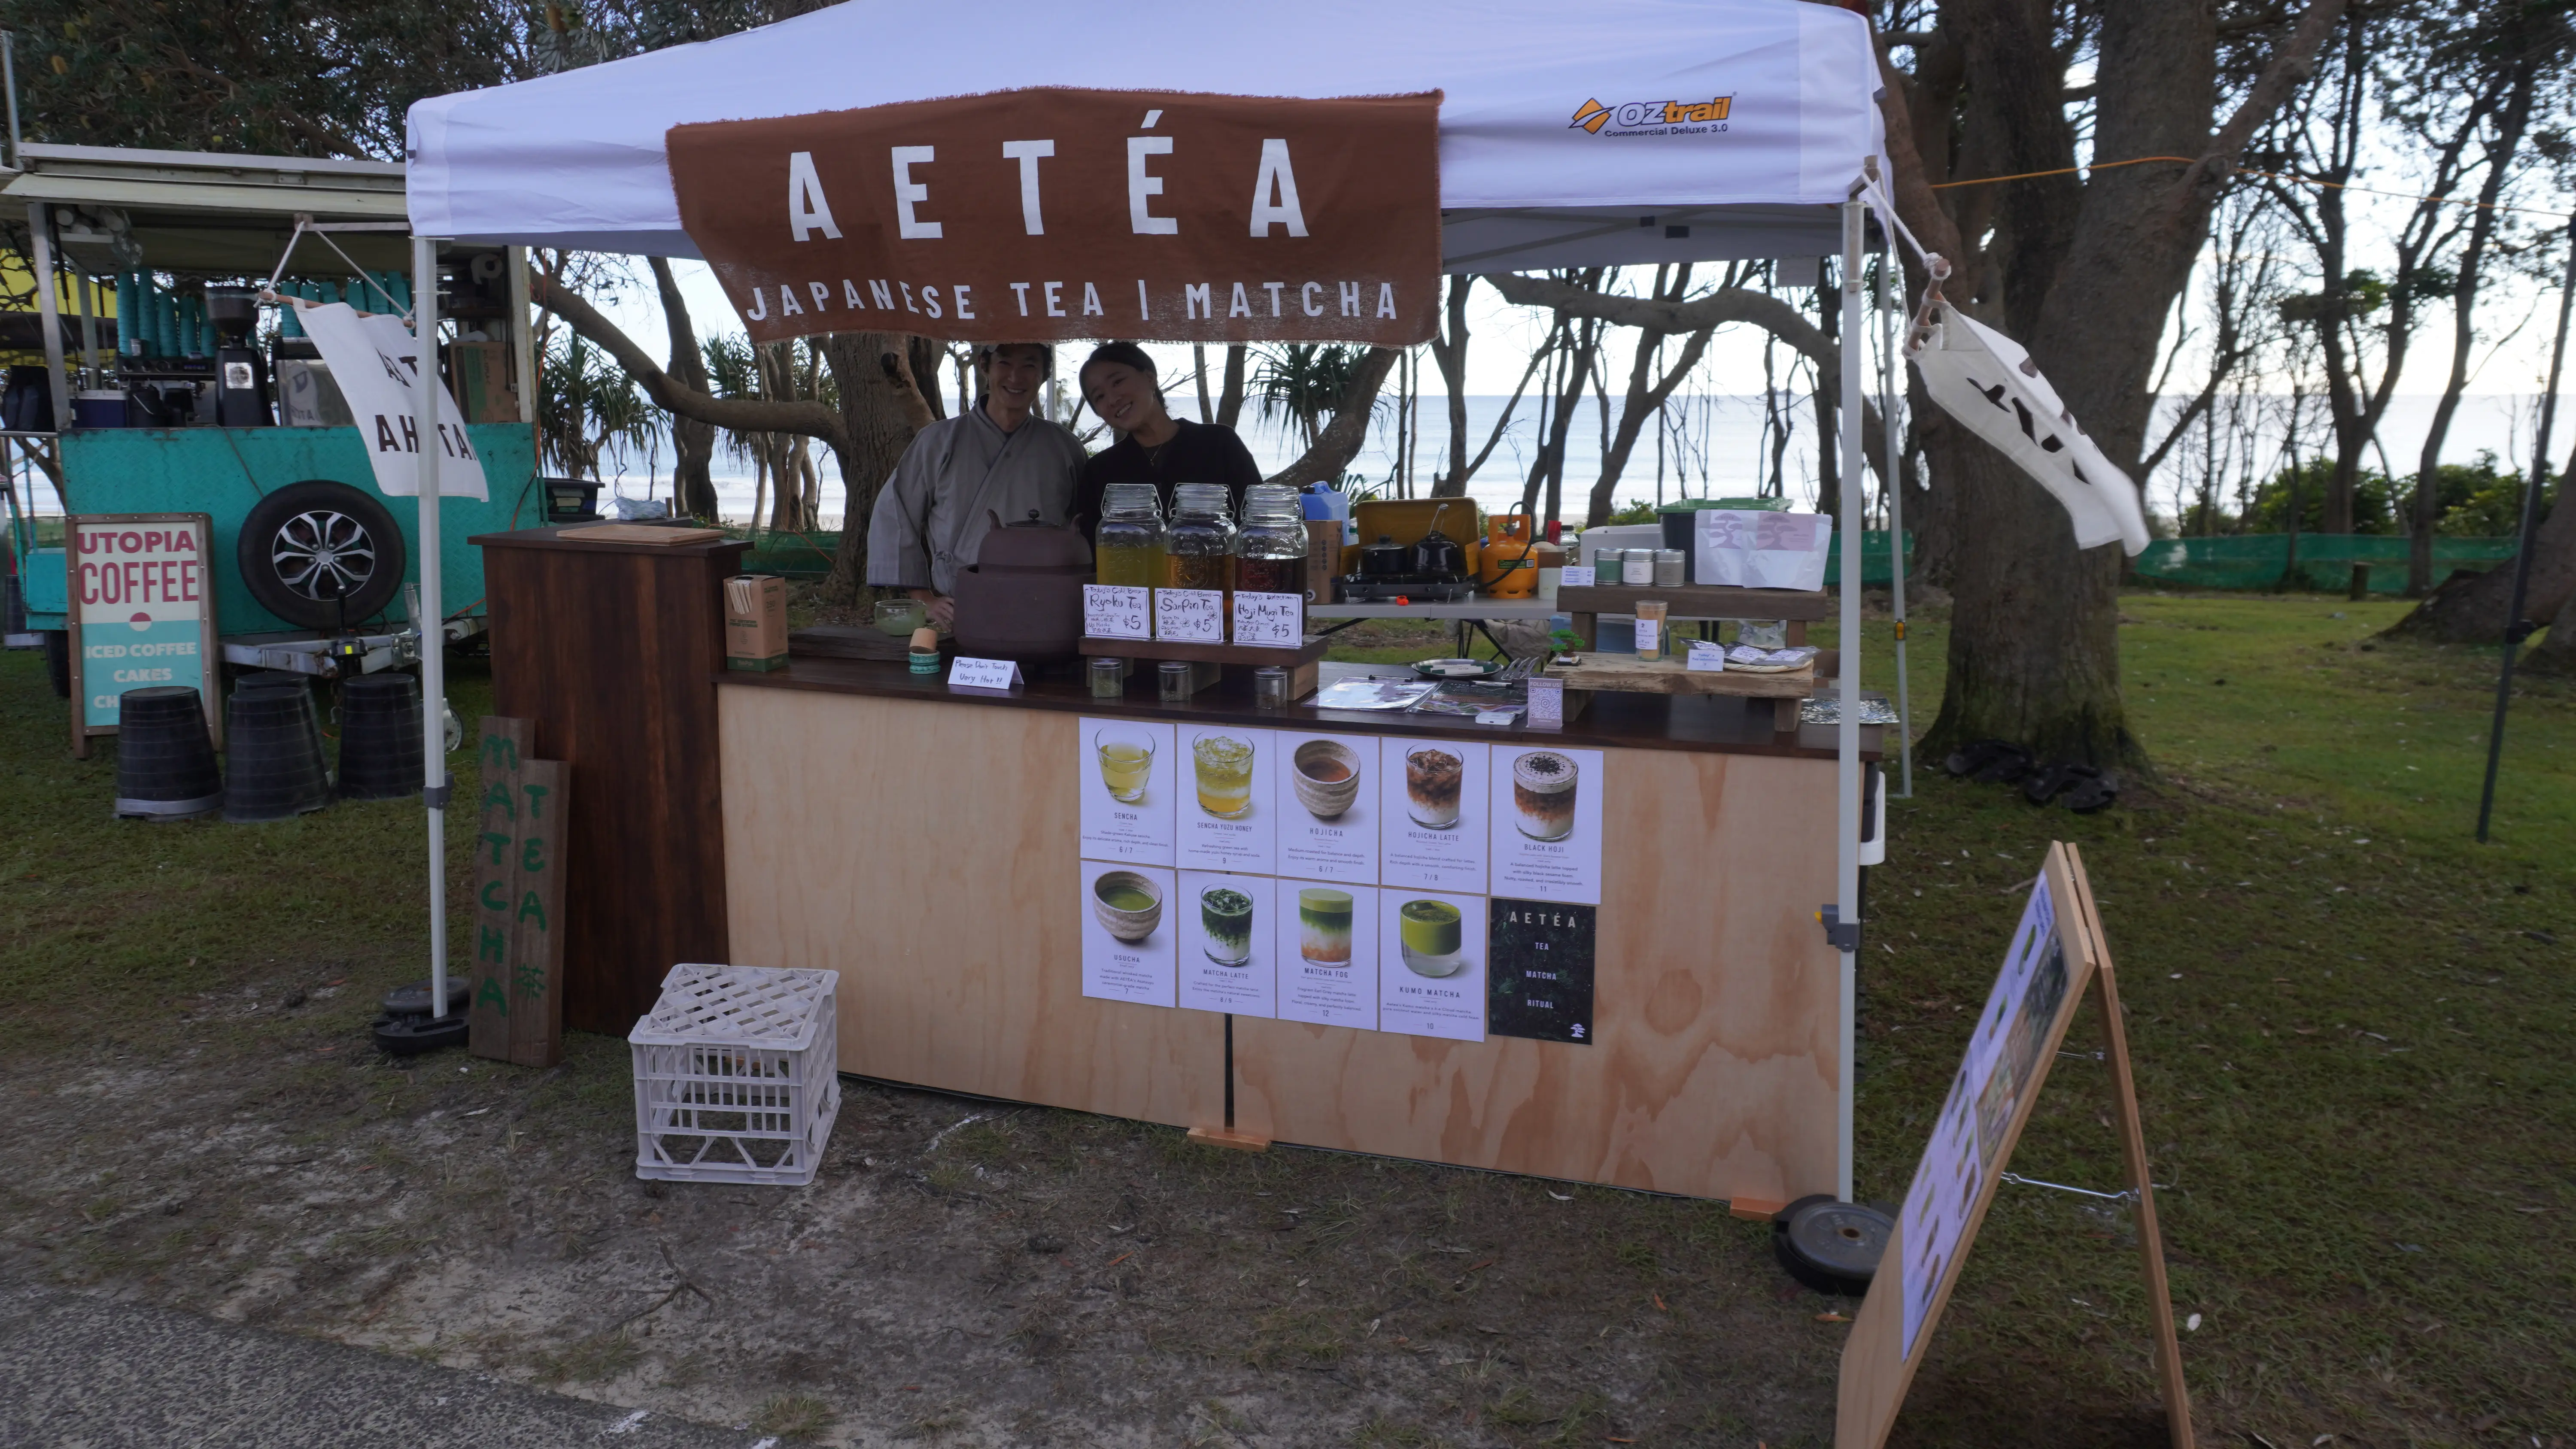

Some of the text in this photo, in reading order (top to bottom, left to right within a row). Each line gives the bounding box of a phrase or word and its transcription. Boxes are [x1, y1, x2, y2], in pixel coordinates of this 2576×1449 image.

[1617, 96, 1732, 127] OZtrail
[1605, 124, 1728, 137] Commercial Deluxe 3.0
[788, 109, 1309, 242] AETÉA
[747, 279, 975, 322] JAPANESE
[1010, 281, 1104, 317] TEA
[1186, 281, 1397, 321] MATCHA
[78, 530, 196, 554] UTOPIA
[79, 560, 199, 605] COFFEE
[1090, 594, 1142, 611] Ryoku Tea
[1242, 593, 1263, 601] Today's
[1200, 599, 1214, 611] Tea
[1239, 603, 1294, 621] Hoji Mugi Tea
[1123, 615, 1141, 630] $5
[1194, 618, 1213, 632] $5
[1272, 623, 1289, 638] $5
[86, 643, 196, 658] ICED COFFEE
[956, 660, 973, 668] Please
[114, 668, 172, 682] CAKES
[960, 673, 975, 683] Very
[981, 676, 993, 684] Hot
[1310, 828, 1343, 837] HOJICHA
[1408, 831, 1437, 840] HOJICHA
[517, 783, 548, 932] TEA
[477, 733, 516, 1018] MATCHA
[1510, 911, 1576, 928] AETÉA
[1535, 942, 1549, 951] TEA
[1114, 955, 1140, 963] USUCHA
[1203, 969, 1227, 977] MATCHA
[1305, 968, 1332, 976] MATCHA
[1526, 970, 1556, 980] MATCHA
[516, 963, 545, 1000] 茶
[1427, 989, 1460, 998] MATCHA
[1527, 999, 1553, 1009] RITUAL
